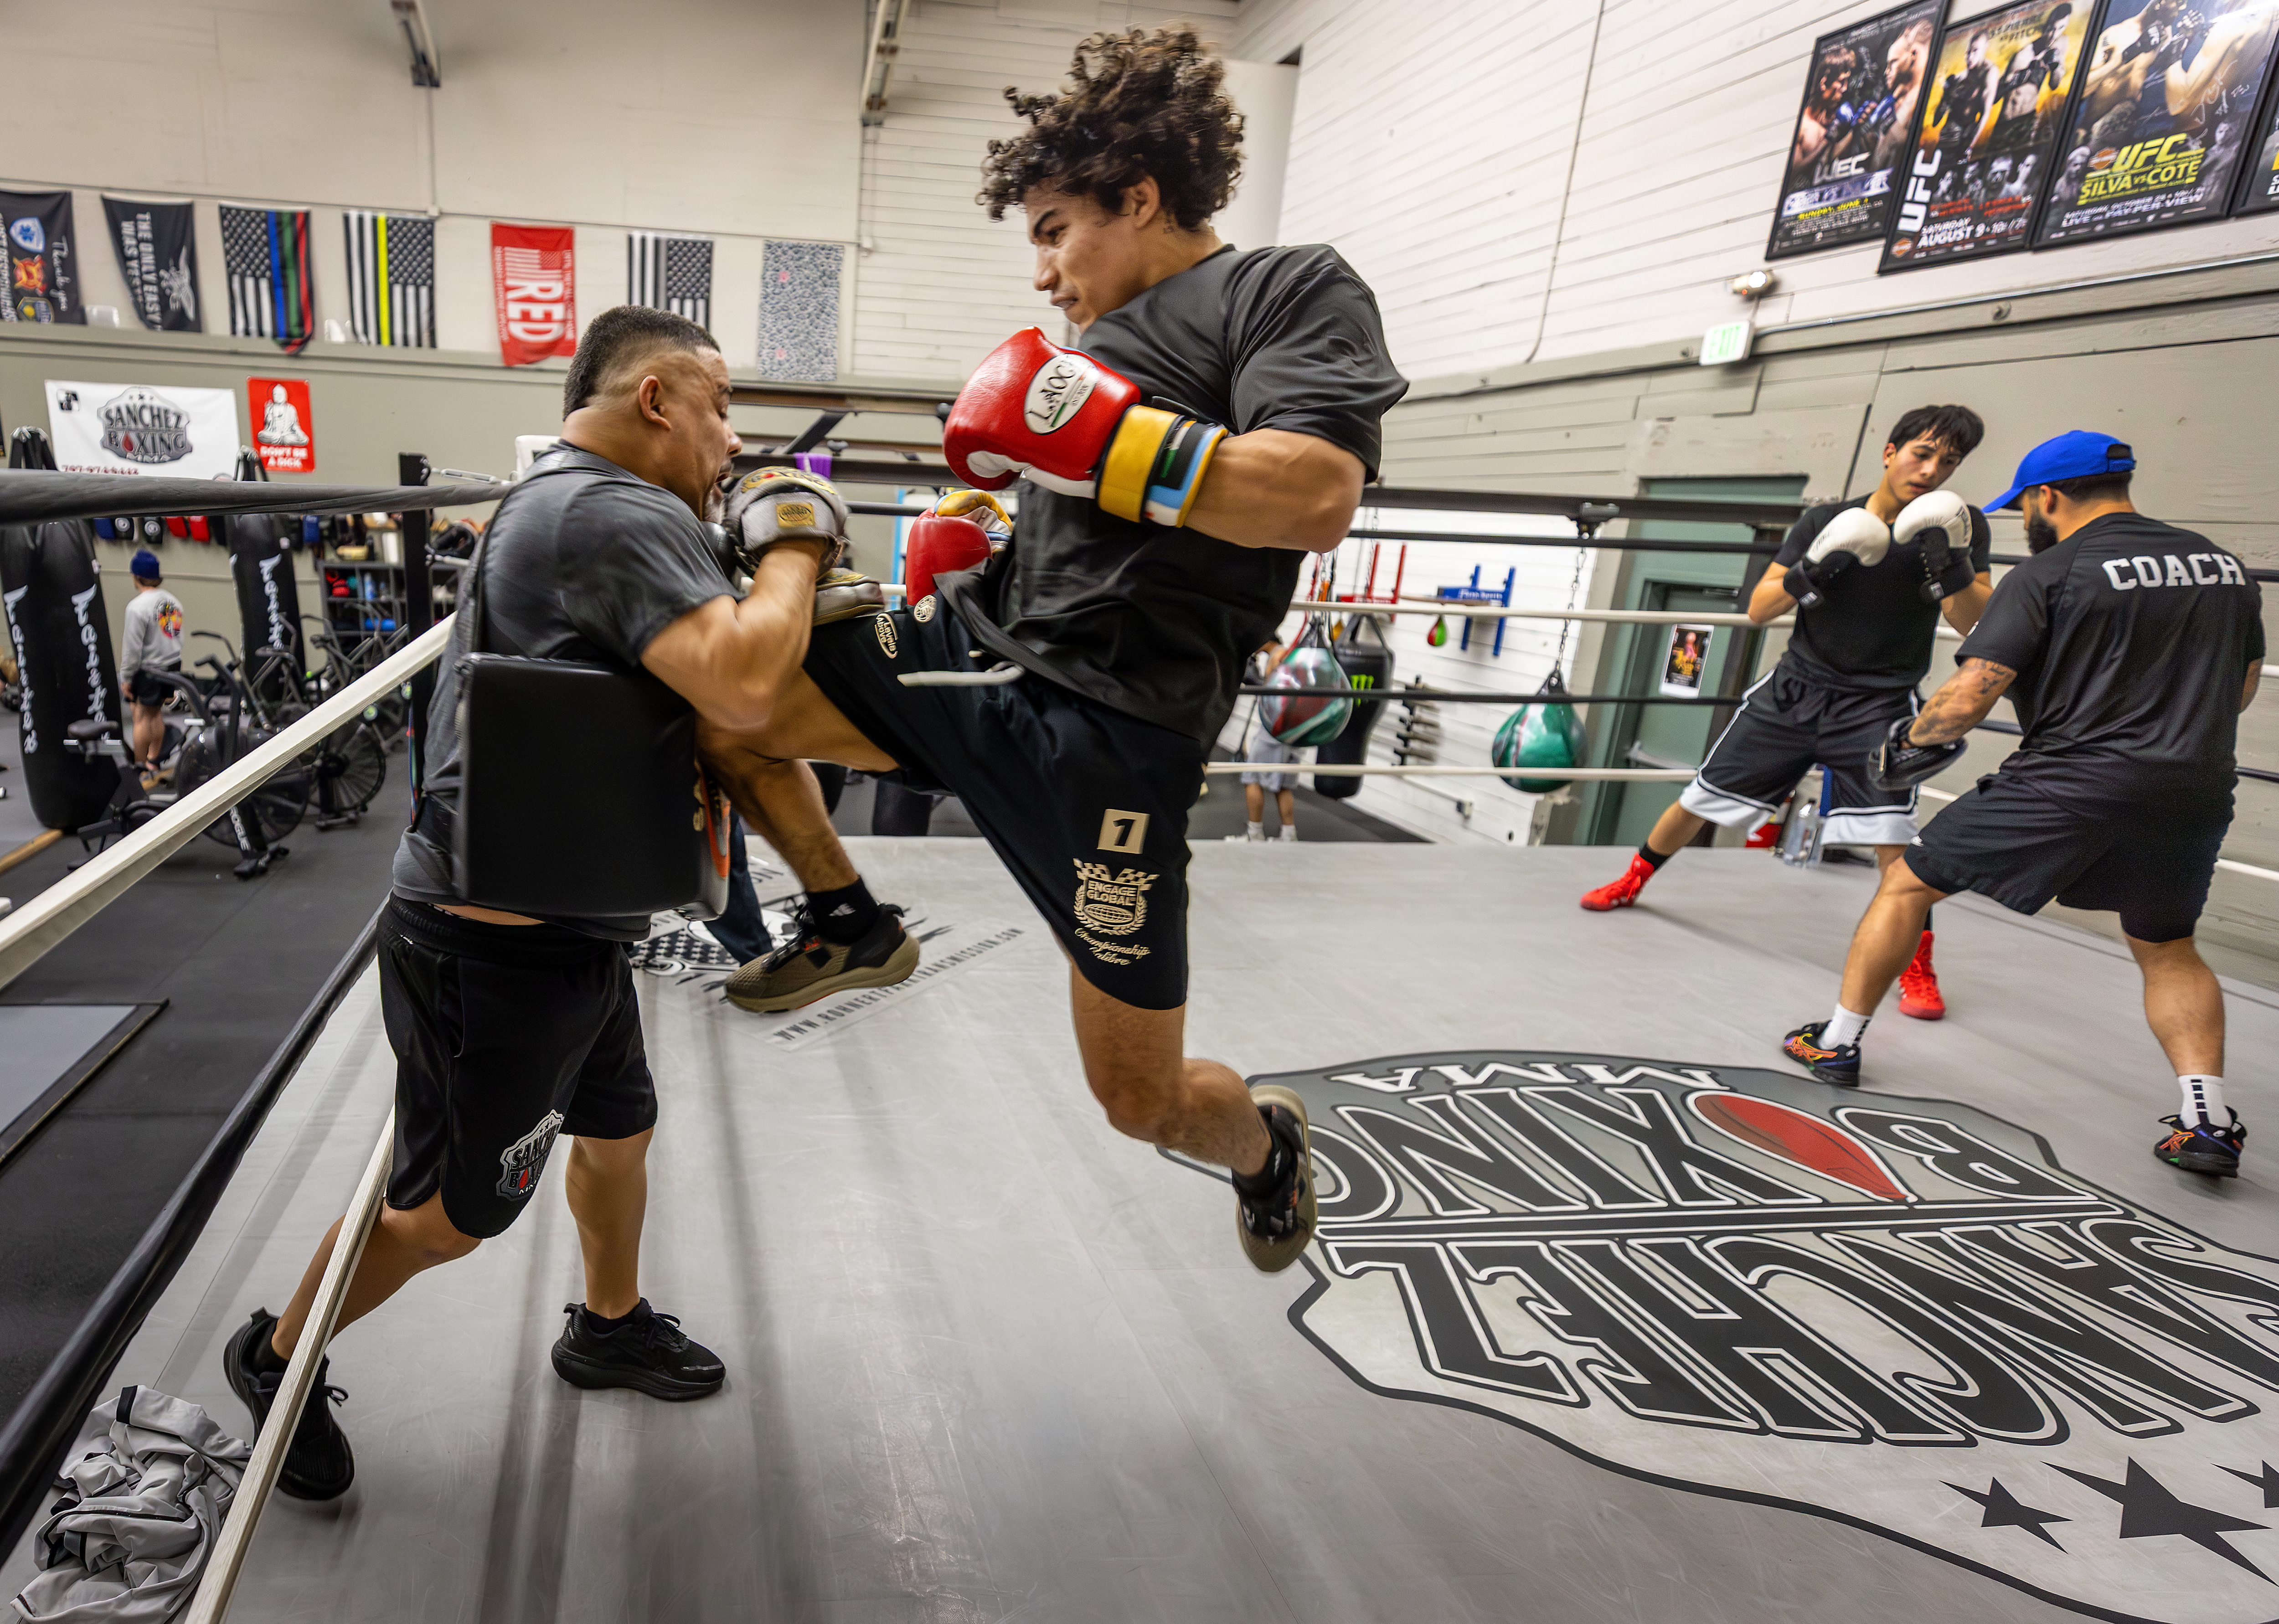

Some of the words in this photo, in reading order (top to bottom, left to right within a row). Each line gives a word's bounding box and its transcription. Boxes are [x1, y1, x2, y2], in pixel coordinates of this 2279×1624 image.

[1813, 151, 1871, 185] WEC
[2111, 132, 2187, 173] UFC
[1897, 149, 1942, 232] UFC
[2079, 175, 2133, 200] SILVA
[2146, 160, 2202, 185] COTE
[2060, 214, 2092, 227] LIVE
[2104, 193, 2205, 219] PAY-PER-VIEW
[121, 220, 139, 259] WAS
[136, 211, 154, 242] THE
[1916, 225, 1975, 249] AUGUST
[1974, 222, 1986, 238] 9
[1920, 217, 1971, 236] SATURDAY
[52, 234, 71, 289] Thank
[139, 242, 158, 285] ONLY
[142, 284, 162, 323] EASY
[505, 278, 565, 343] RED
[1707, 324, 1742, 360] EXIT
[126, 452, 171, 463] MMA
[259, 445, 292, 458] DON'T
[292, 447, 309, 460] BE
[267, 455, 277, 467] A
[276, 456, 303, 469] DICK
[2102, 553, 2246, 592] COACH
[876, 617, 887, 644] Above
[883, 621, 897, 652] Levels
[1113, 819, 1137, 847] 1
[1086, 889, 1136, 907] GLOBAL
[1088, 880, 1138, 897] ENGAGE
[1074, 928, 1152, 959] Championship
[1089, 946, 1132, 965] Calibre
[1329, 1062, 1739, 1093] MMA
[1324, 1216, 2279, 1445] SANCHEZ
